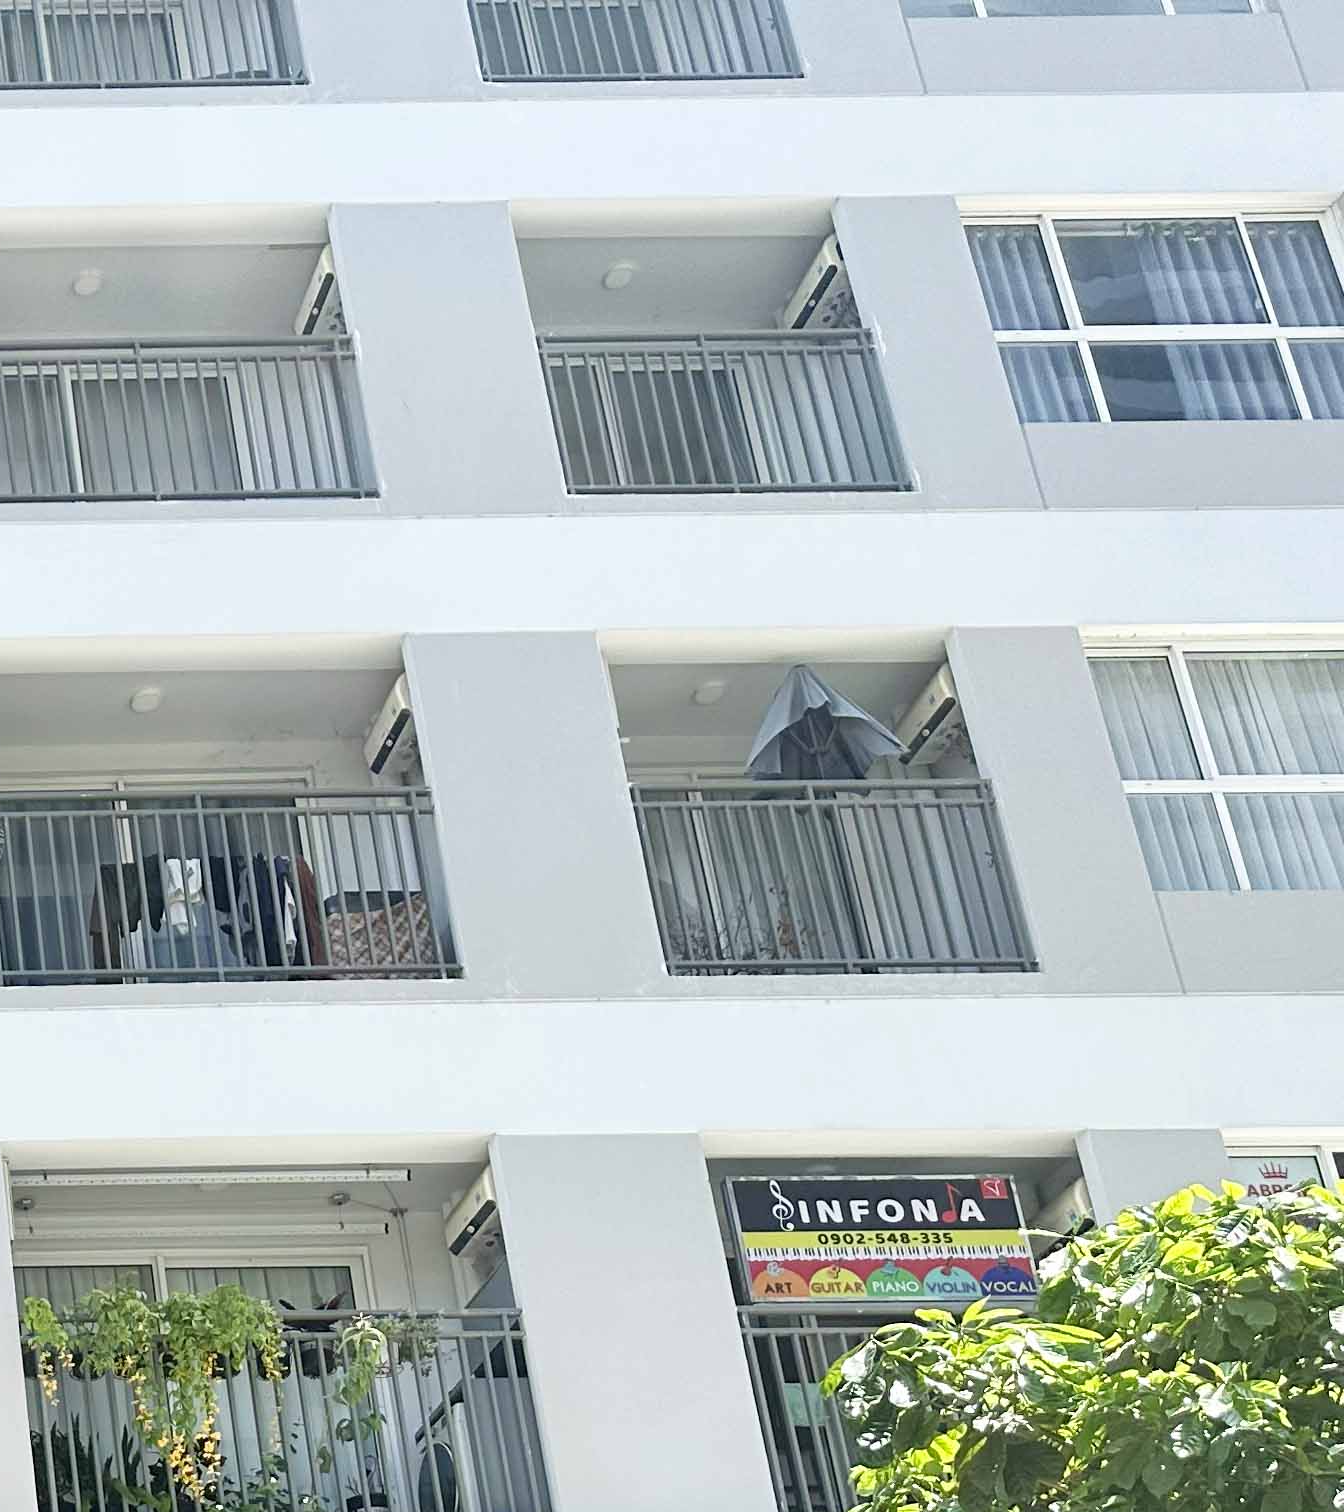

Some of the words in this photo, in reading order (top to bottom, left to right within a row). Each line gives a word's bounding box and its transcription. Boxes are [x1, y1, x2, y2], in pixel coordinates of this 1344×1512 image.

[817, 1231, 954, 1246] 0902-548-335
[764, 1280, 793, 1294] ART
[811, 1280, 864, 1294] GUITAR
[871, 1280, 920, 1293] PIANO
[925, 1281, 977, 1294] VIOLIN
[981, 1280, 1037, 1293] VOCAL
